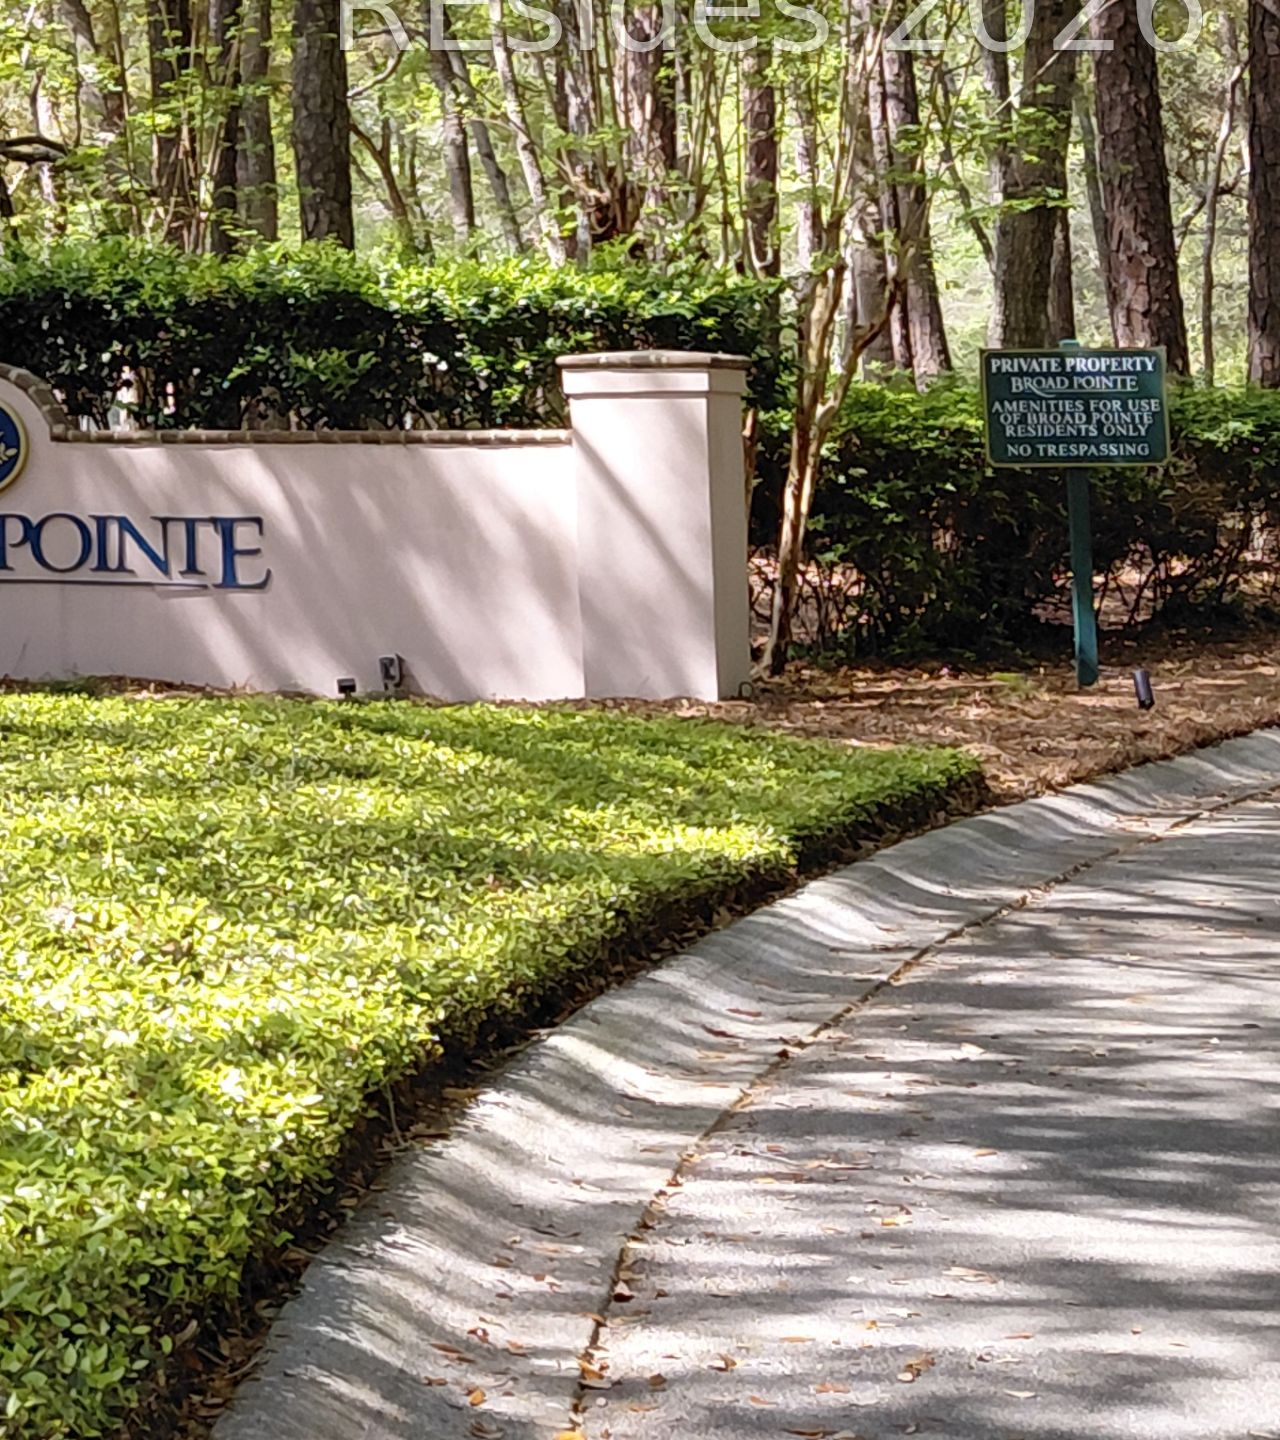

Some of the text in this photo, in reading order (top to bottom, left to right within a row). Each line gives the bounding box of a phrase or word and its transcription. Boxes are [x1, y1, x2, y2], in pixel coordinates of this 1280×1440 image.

[990, 357, 1157, 373] PRIVATE PROPERTY
[1011, 376, 1139, 398] BROAD POINTE
[992, 398, 1161, 413] AMENITIES FOR USE
[999, 412, 1154, 425] OF BROAD POINTE
[1005, 424, 1149, 438] RESIDENTS ONLY
[1007, 443, 1150, 457] NO TRESPASSING
